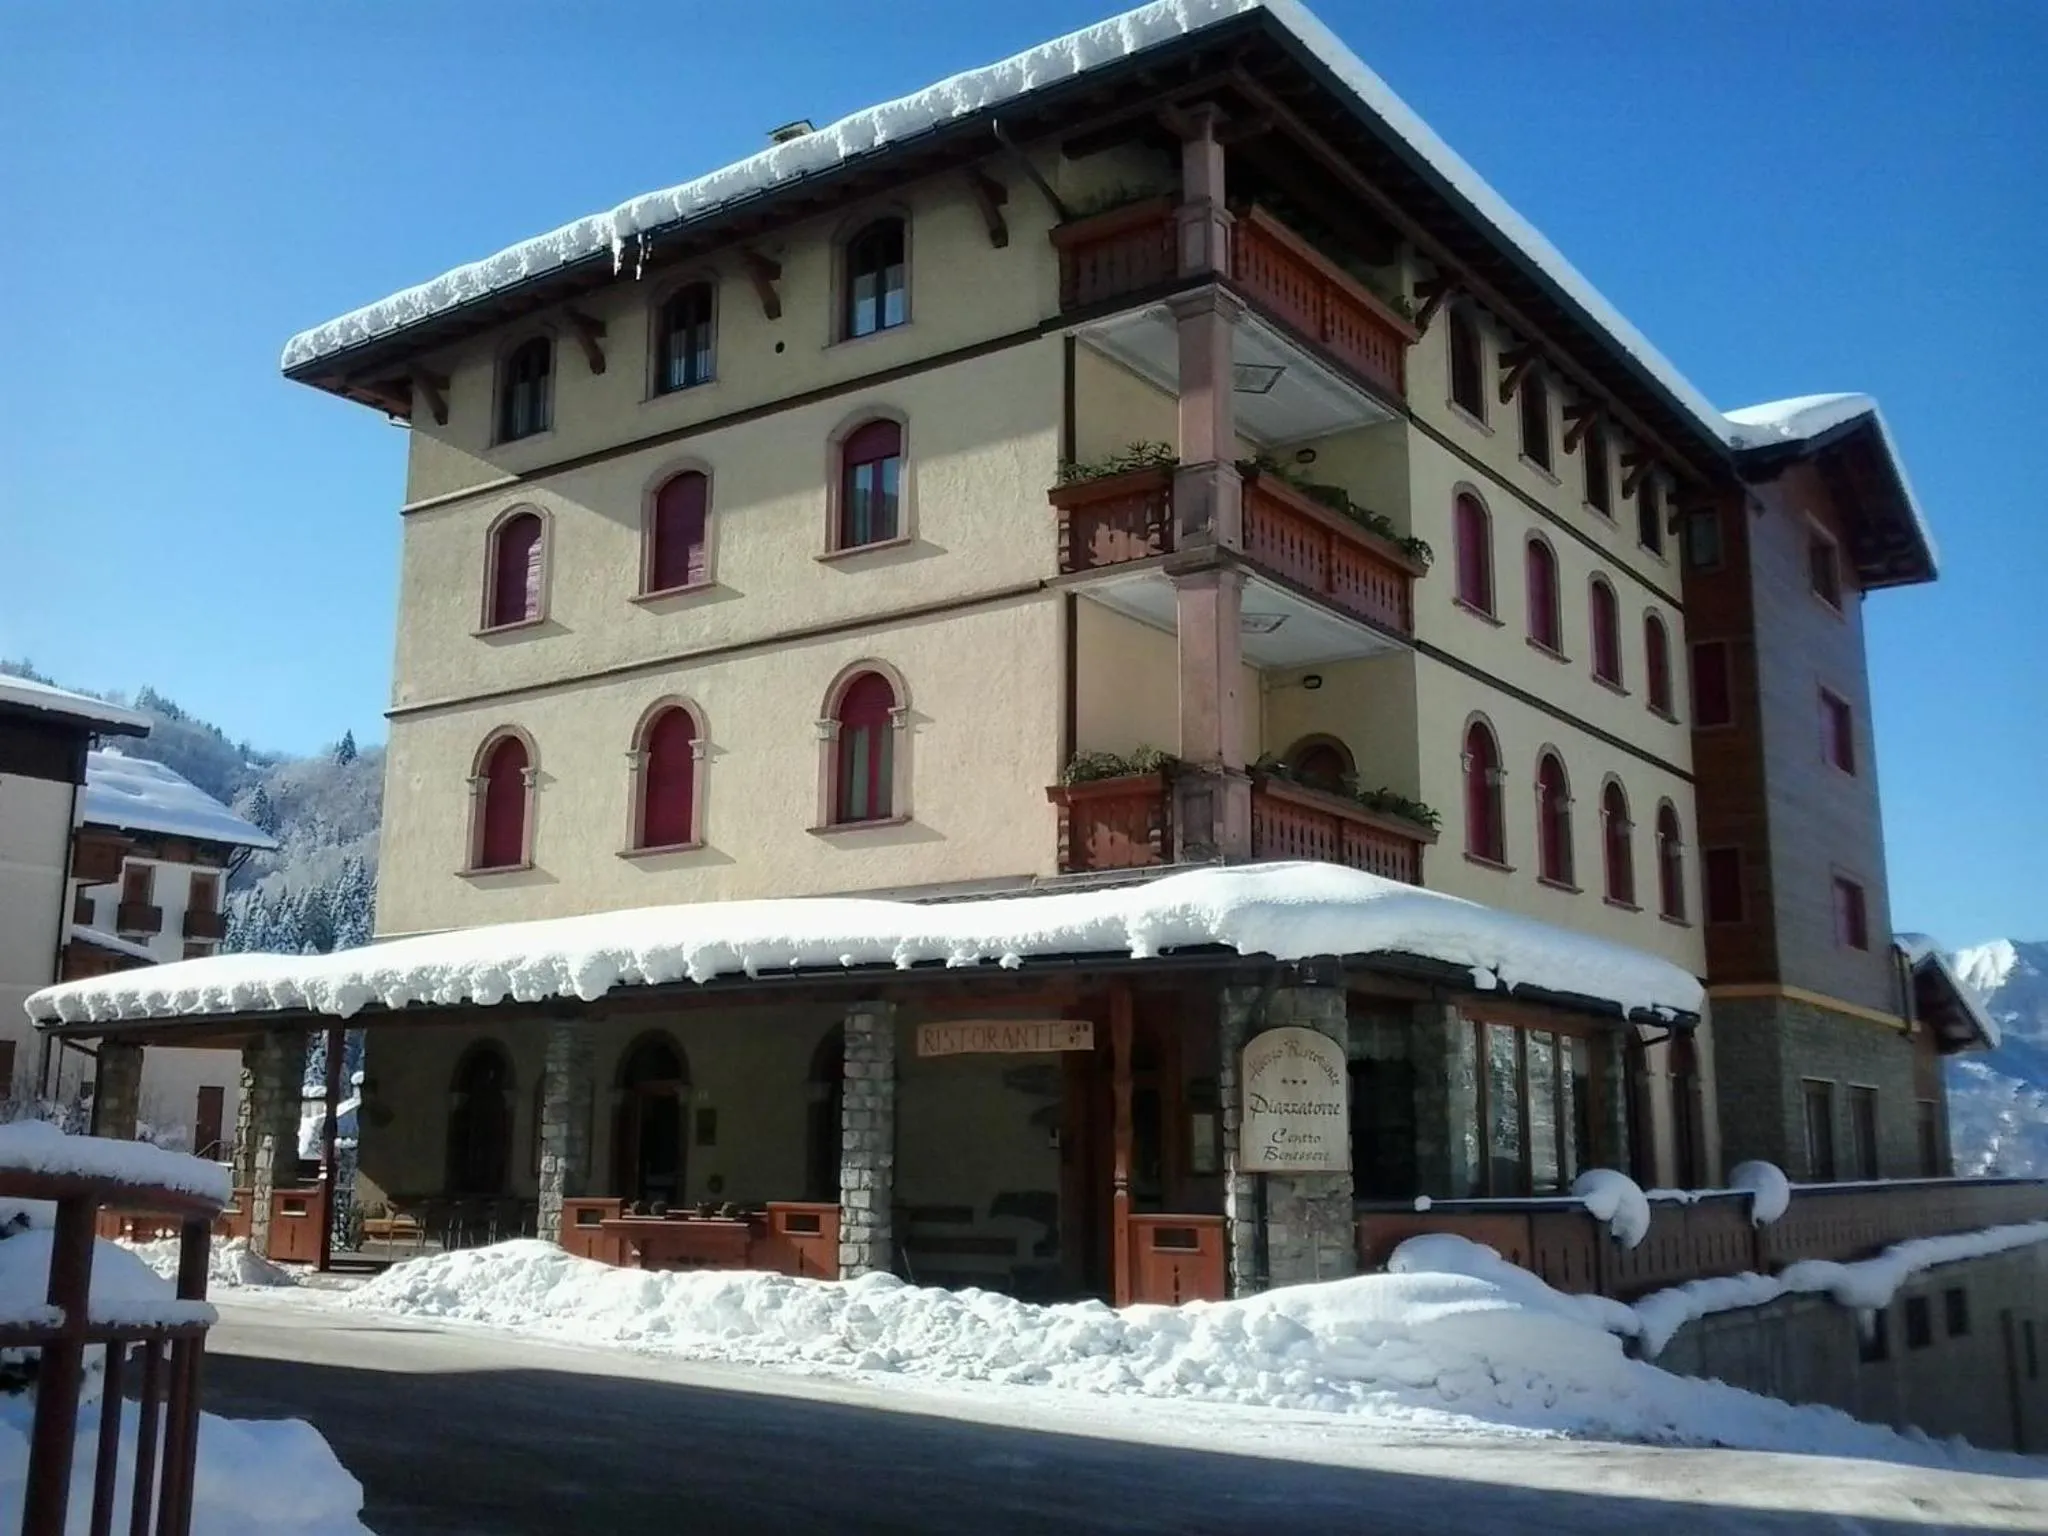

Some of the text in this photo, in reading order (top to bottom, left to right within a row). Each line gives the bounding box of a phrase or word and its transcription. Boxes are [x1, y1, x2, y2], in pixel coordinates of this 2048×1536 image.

[924, 1022, 1060, 1052] RISTORANTE
[1248, 1092, 1341, 1121] Piazzatorre
[1271, 1128, 1321, 1144] Centro
[1264, 1146, 1330, 1161] Benessere
